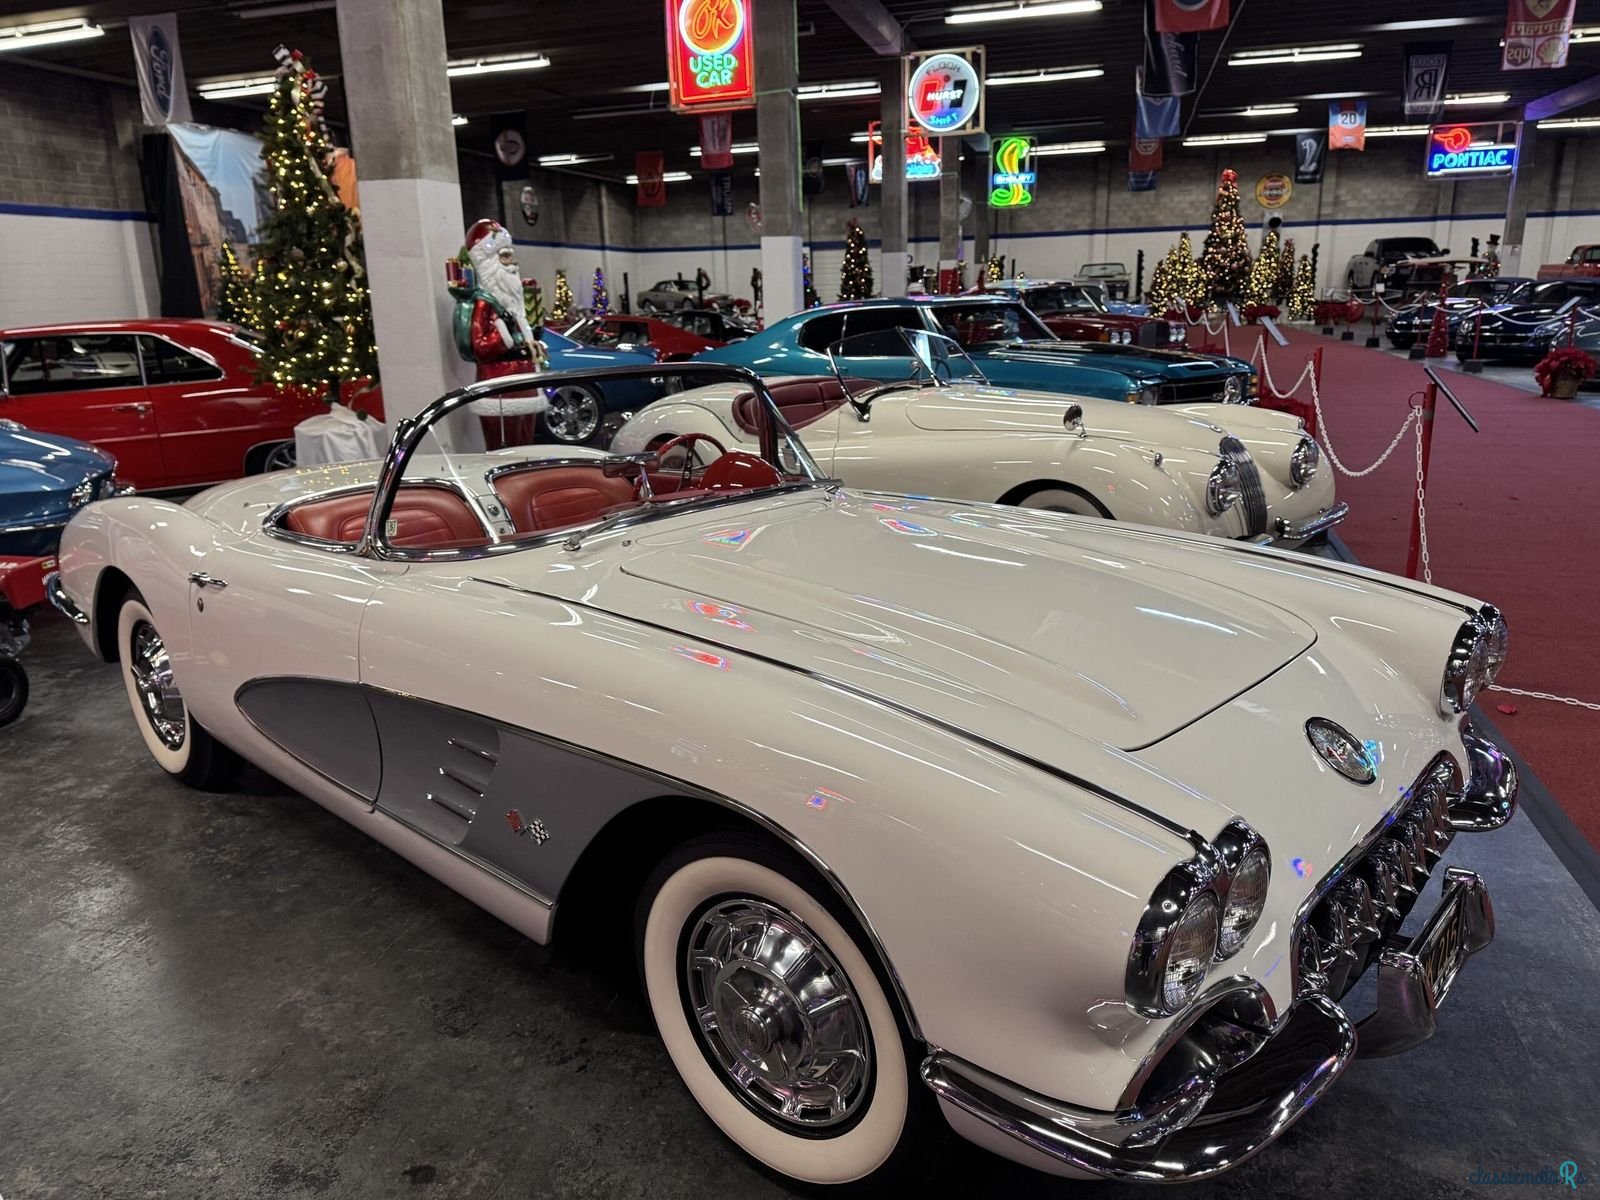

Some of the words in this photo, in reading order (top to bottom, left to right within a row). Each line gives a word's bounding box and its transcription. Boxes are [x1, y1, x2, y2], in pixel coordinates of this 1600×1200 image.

[694, 0, 735, 39] OK
[689, 54, 738, 73] USED
[150, 45, 170, 101] Ford
[696, 69, 733, 89] CAR
[927, 90, 963, 101] HURST
[928, 112, 959, 125] SHIFT
[1341, 113, 1357, 125] 20
[1433, 150, 1508, 168] PONTIAC
